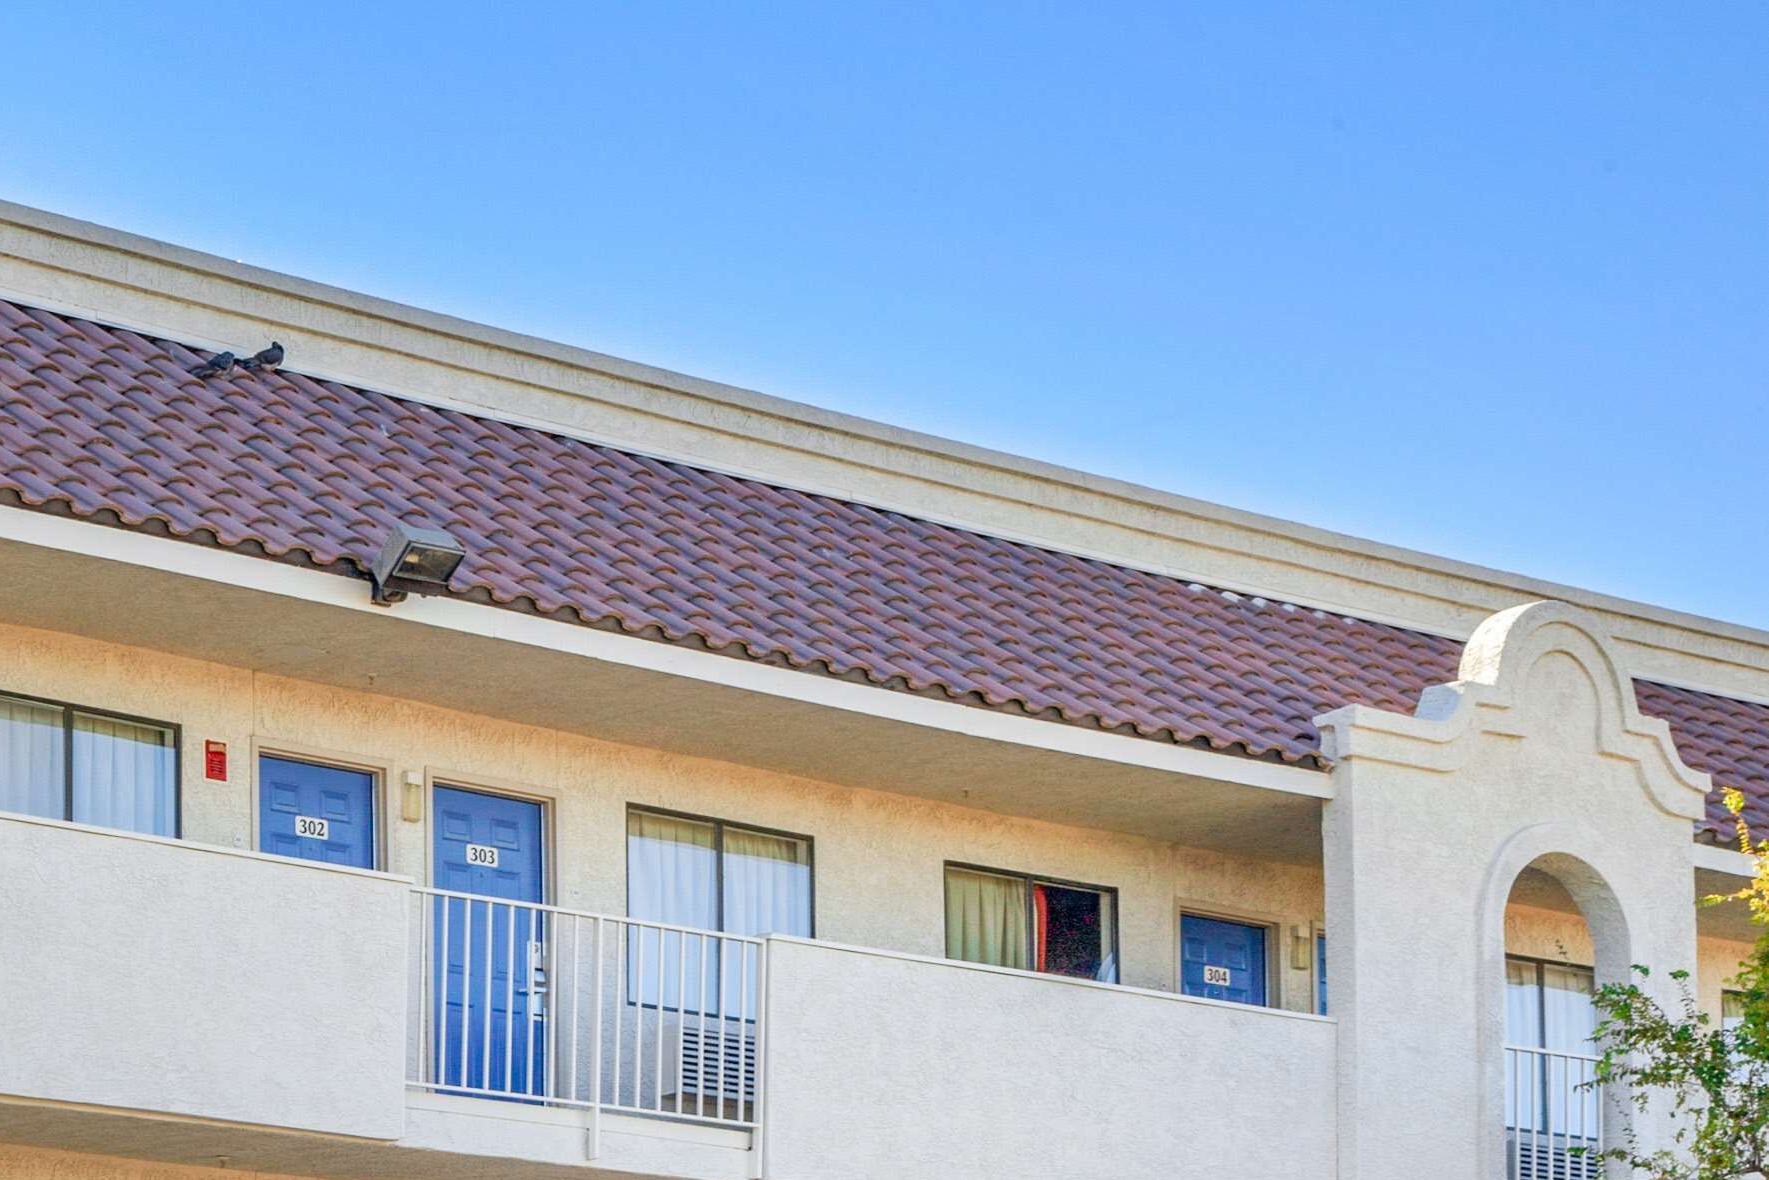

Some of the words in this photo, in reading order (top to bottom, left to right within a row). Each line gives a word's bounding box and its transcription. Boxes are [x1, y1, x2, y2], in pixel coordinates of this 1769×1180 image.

[300, 819, 325, 837] 302
[471, 847, 495, 864] 303
[1206, 968, 1227, 983] 304
